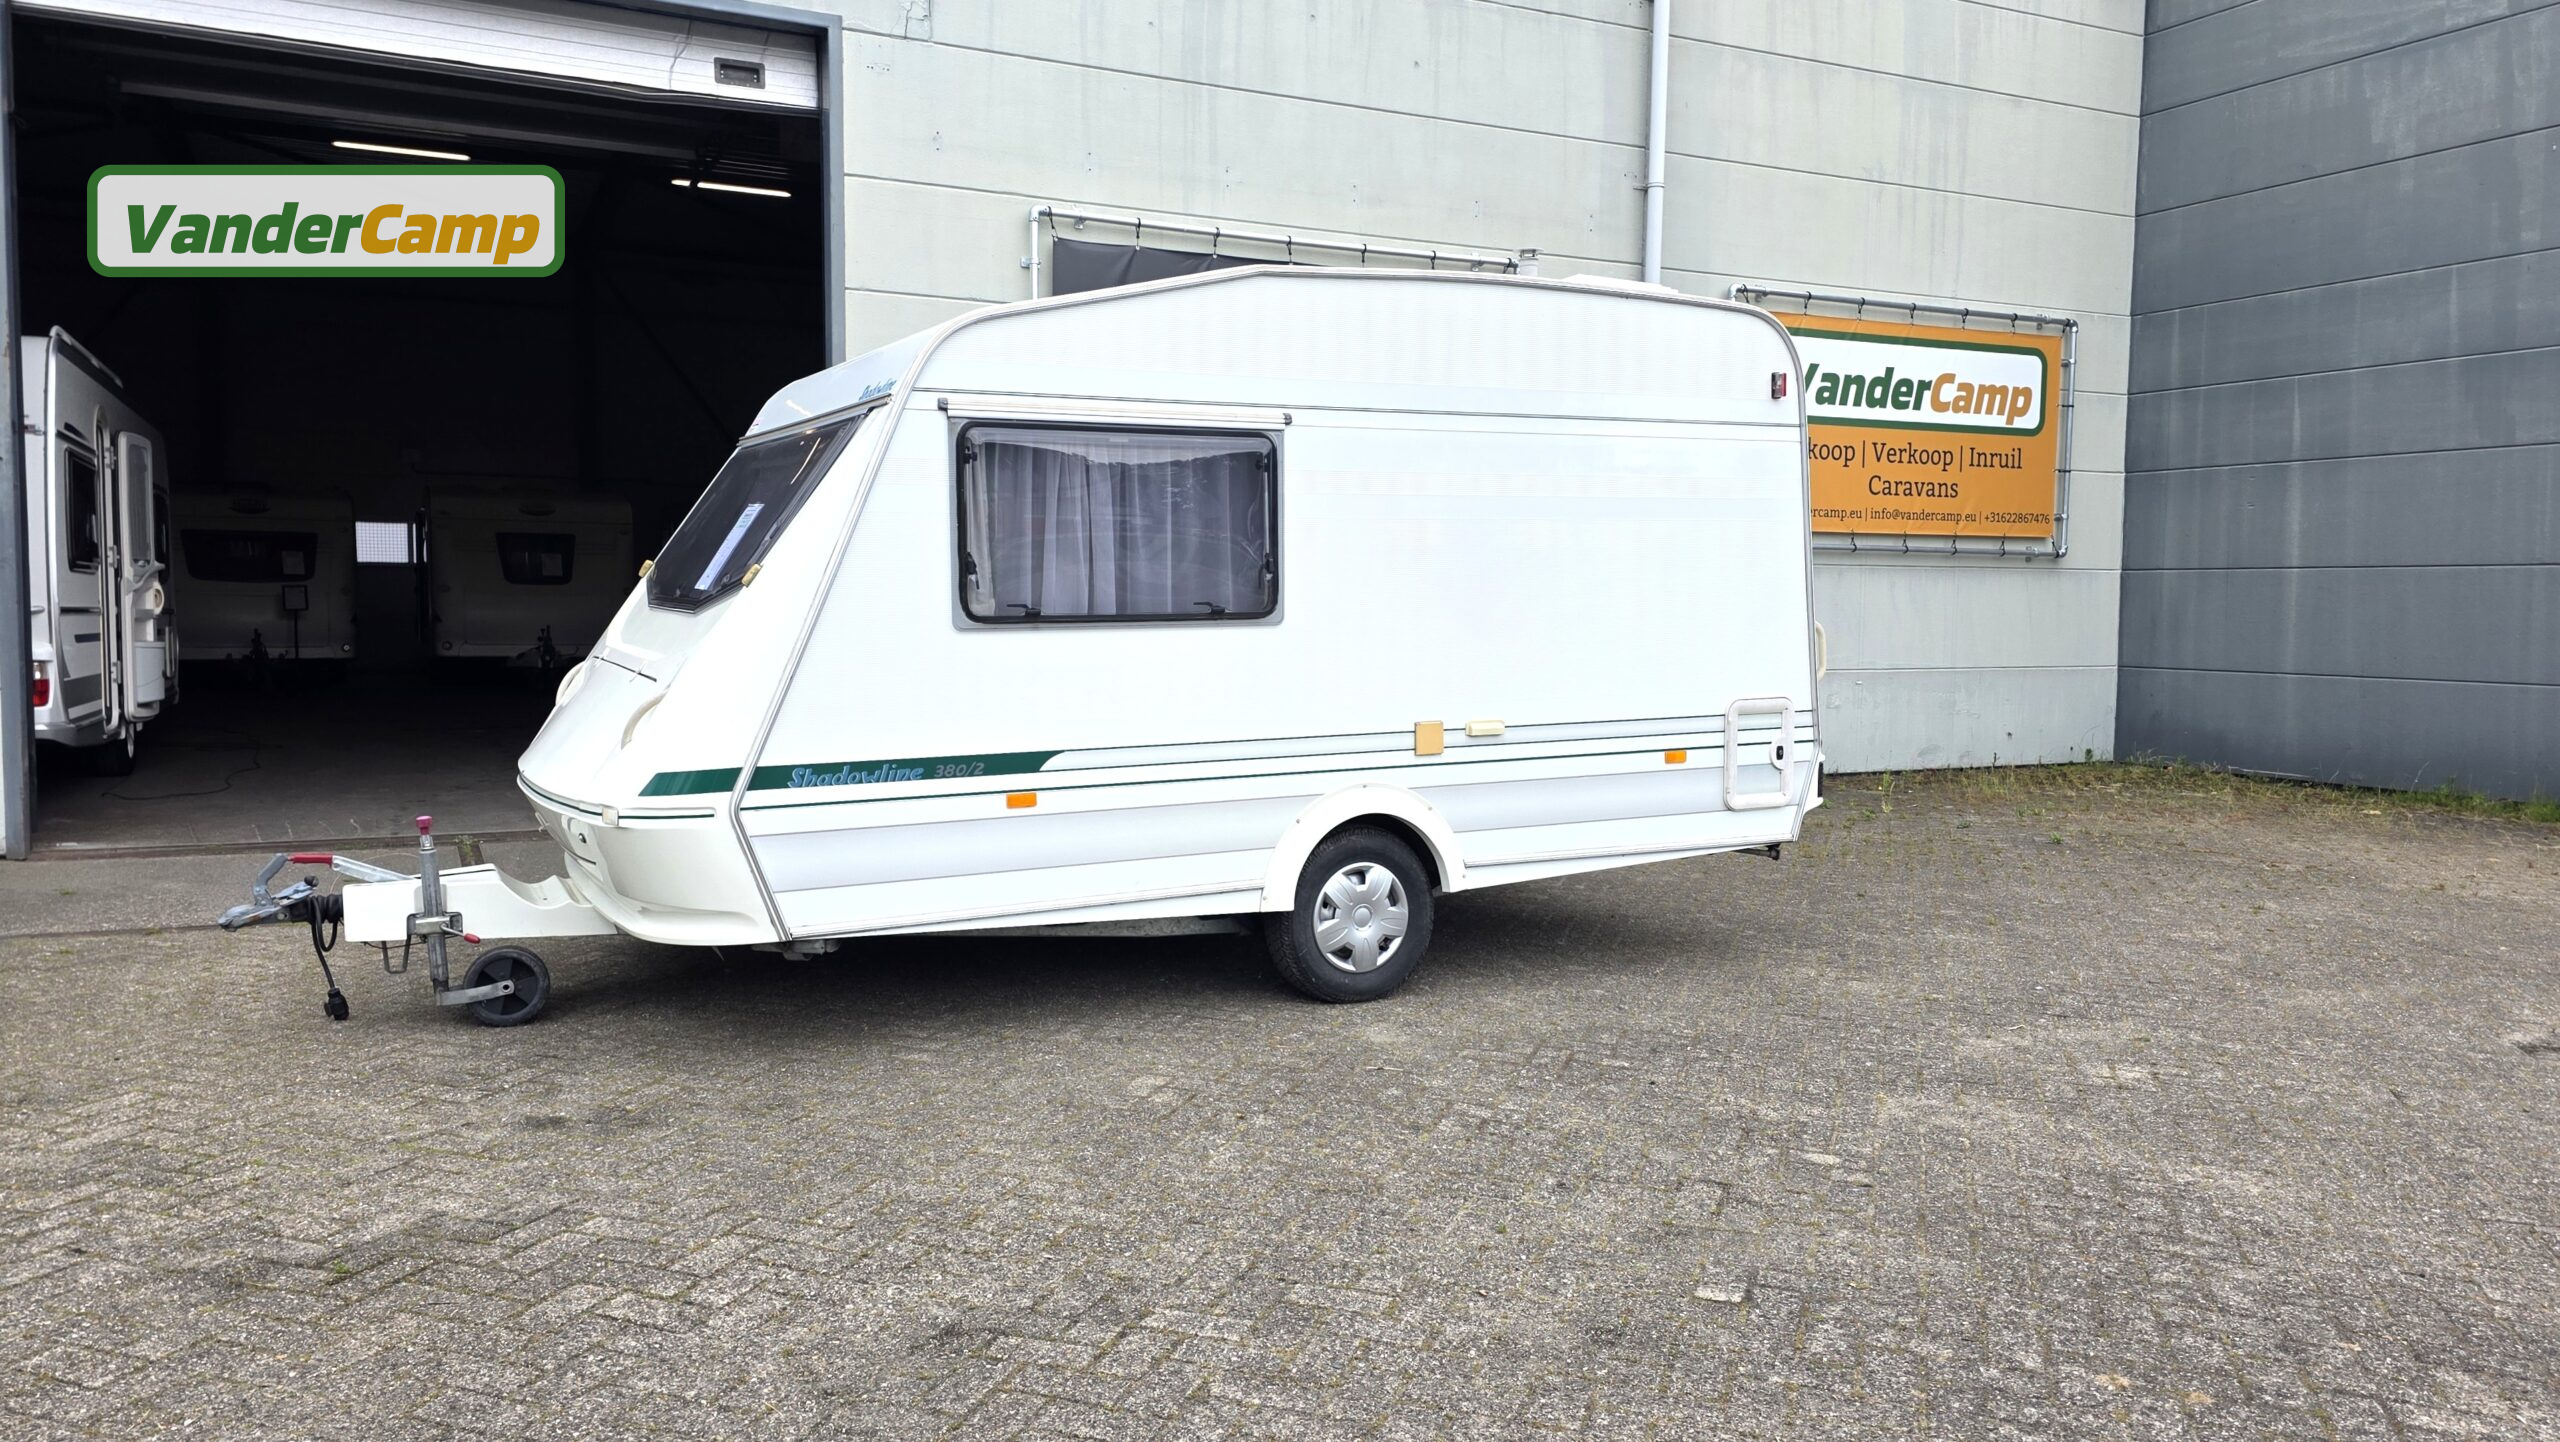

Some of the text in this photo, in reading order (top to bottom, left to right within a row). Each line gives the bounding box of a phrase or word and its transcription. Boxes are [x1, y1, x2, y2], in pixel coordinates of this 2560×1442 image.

[1871, 442, 1954, 471] Verkoop
[1968, 447, 2023, 469] Inruil
[1868, 475, 1959, 498] Caravans
[1870, 507, 1976, 525] info@vandercamp.eu
[1984, 511, 2050, 525] +31622867476
[787, 762, 985, 788] Shadowline 380/2
